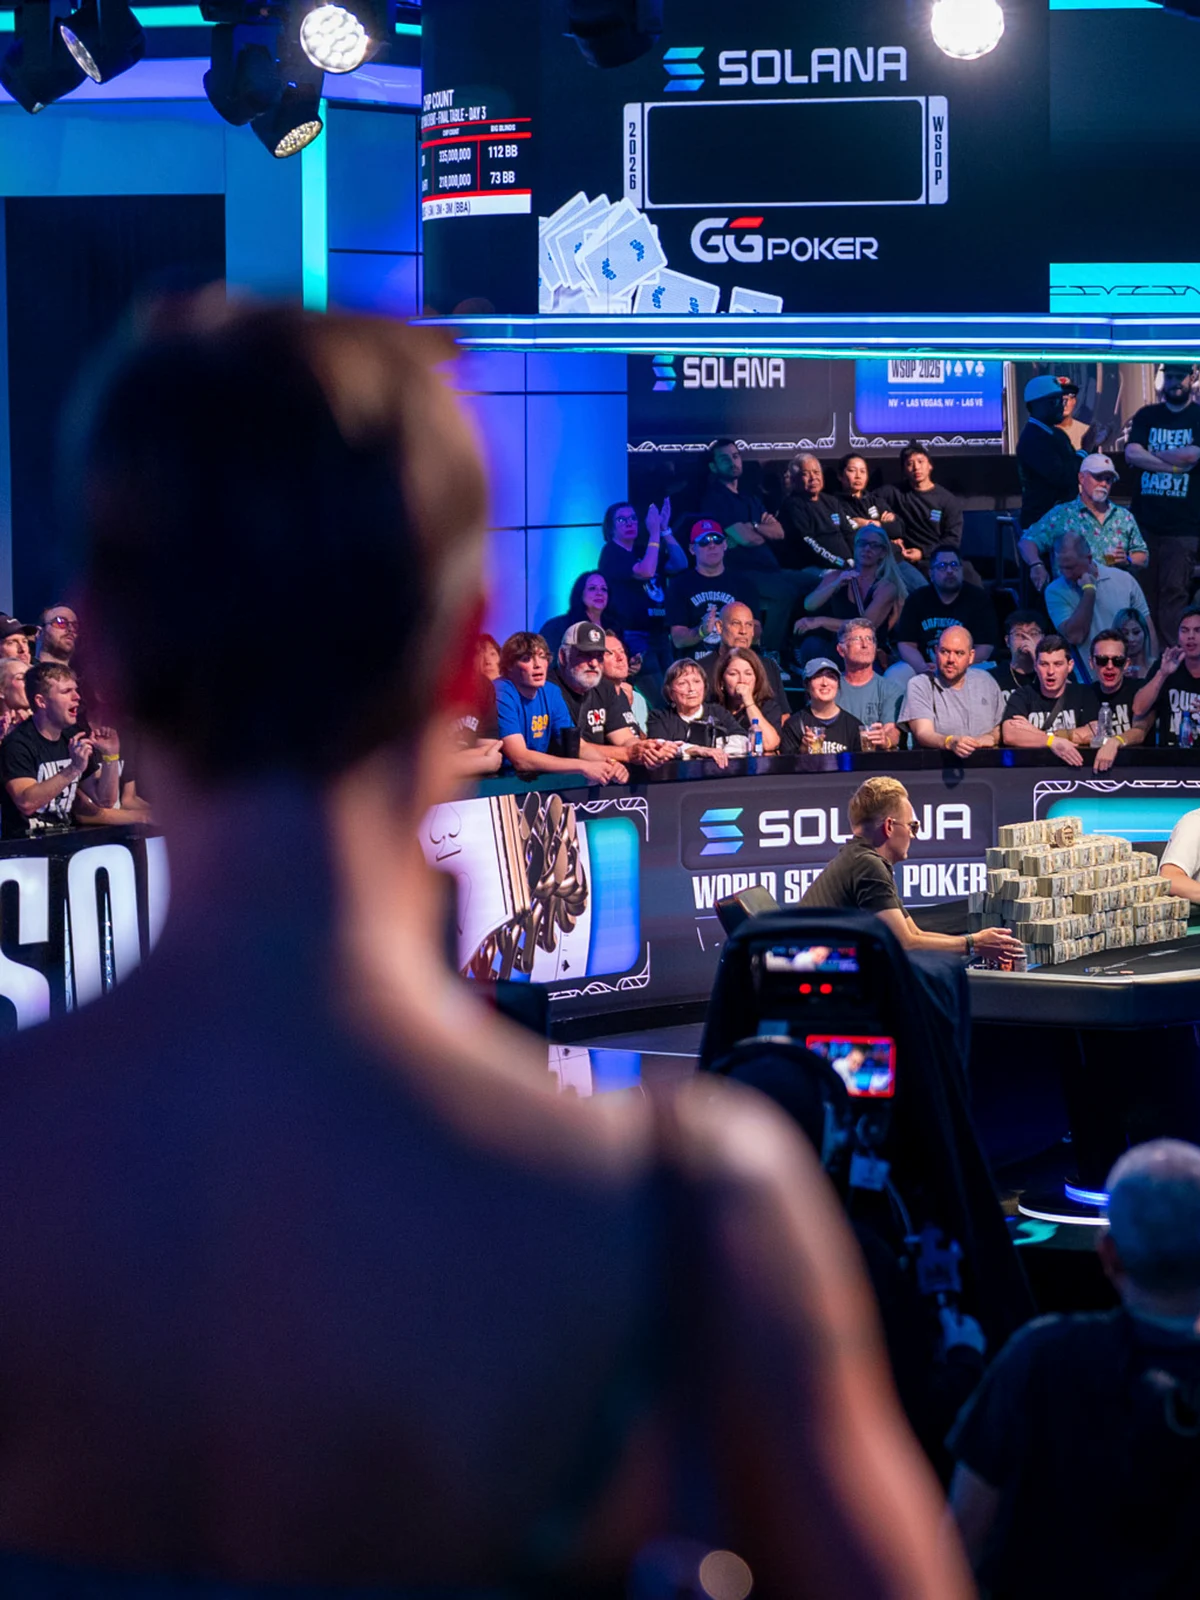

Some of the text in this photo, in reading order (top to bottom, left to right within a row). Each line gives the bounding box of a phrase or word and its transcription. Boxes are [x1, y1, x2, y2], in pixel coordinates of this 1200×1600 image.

[718, 46, 908, 86] SOLANA
[432, 89, 454, 109] COUNT
[481, 105, 487, 120] 3
[488, 145, 518, 158] 112 BB
[628, 121, 637, 190] 2026
[932, 115, 944, 186] WSOP
[490, 171, 515, 184] 73 BB
[454, 200, 471, 216] (BBA)
[690, 216, 879, 263] GGPOKER
[683, 357, 785, 389] SOLANA
[891, 360, 941, 378] WSOP 2026
[888, 399, 898, 407] NV
[906, 399, 919, 407] LAS
[920, 399, 943, 408] VEGAS,
[944, 399, 955, 407] NV
[961, 399, 974, 407] LAS
[1148, 428, 1193, 445] QUEEN
[1028, 709, 1077, 729] QUEN
[758, 803, 972, 848] SOLA
[903, 863, 988, 897] POKER
